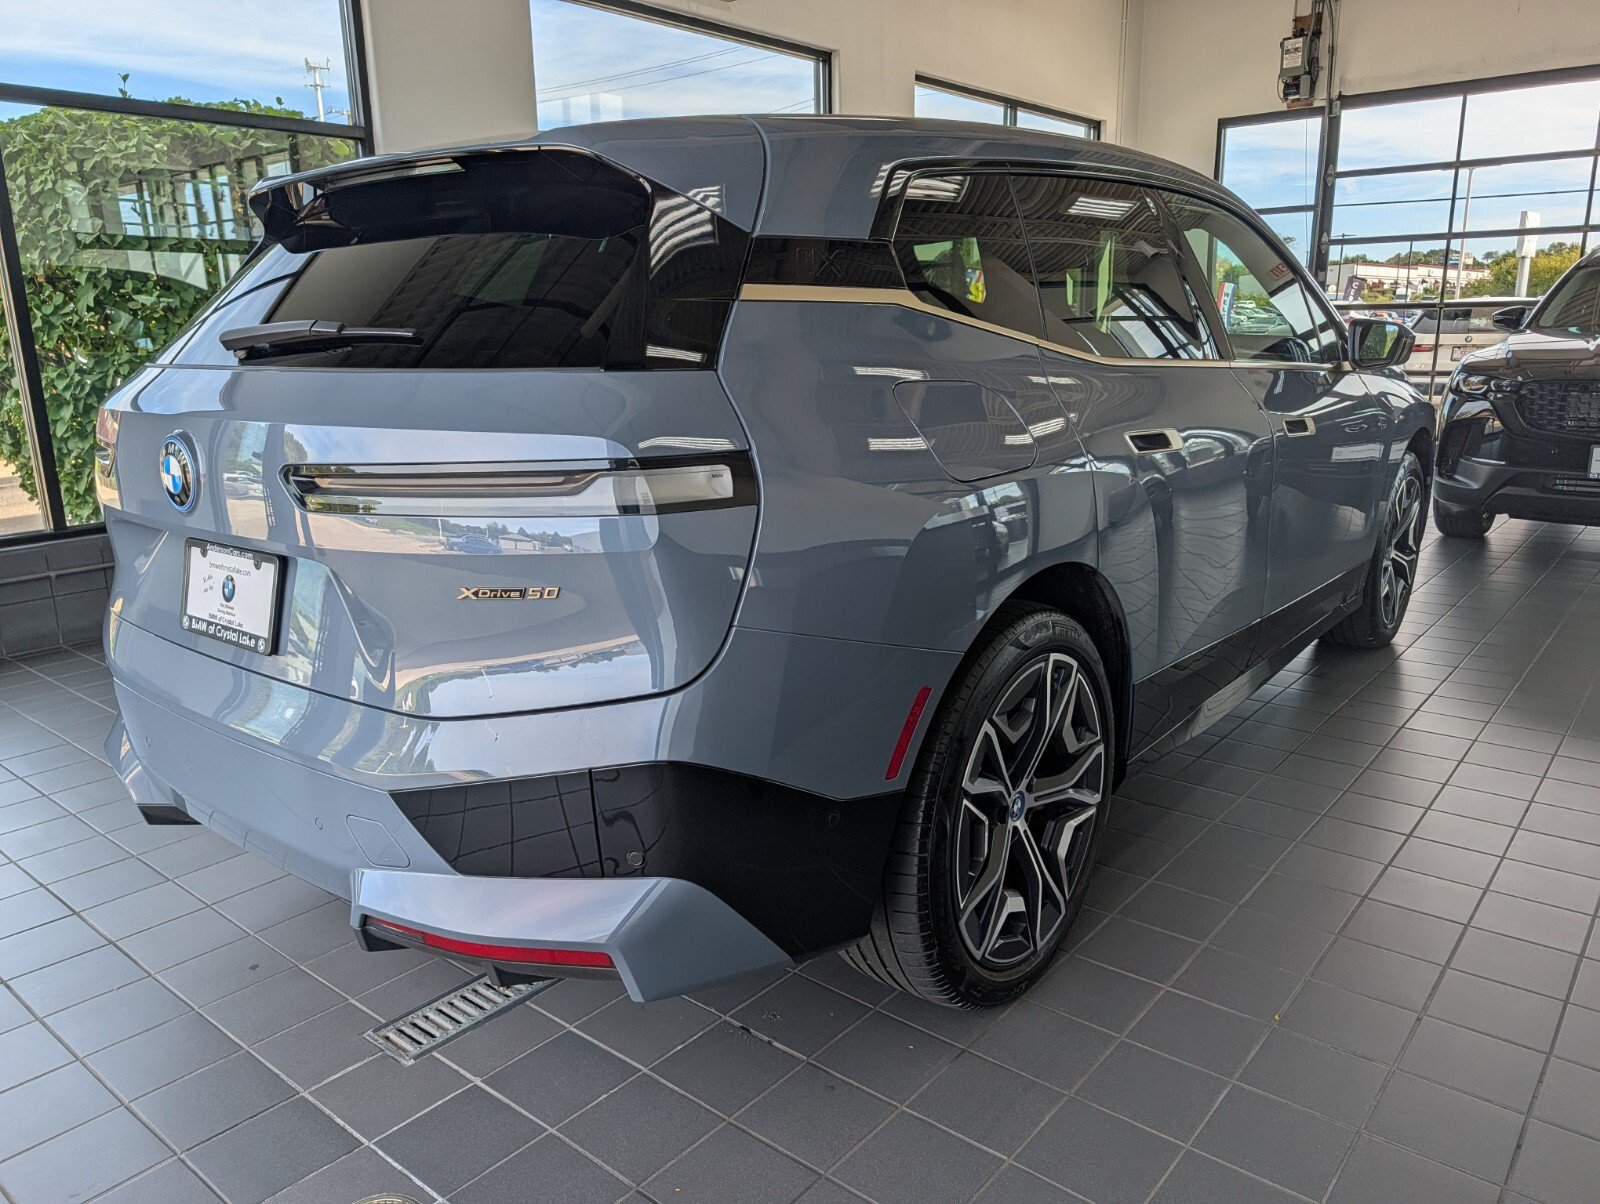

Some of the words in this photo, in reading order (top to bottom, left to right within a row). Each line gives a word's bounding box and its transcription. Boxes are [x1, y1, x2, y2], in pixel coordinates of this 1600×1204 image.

[206, 543, 254, 560] AndersonCars.com
[527, 586, 561, 600] 50
[191, 617, 208, 632] BMW
[208, 624, 216, 634] of
[215, 625, 239, 642] Crystal
[239, 631, 256, 648] Lake
